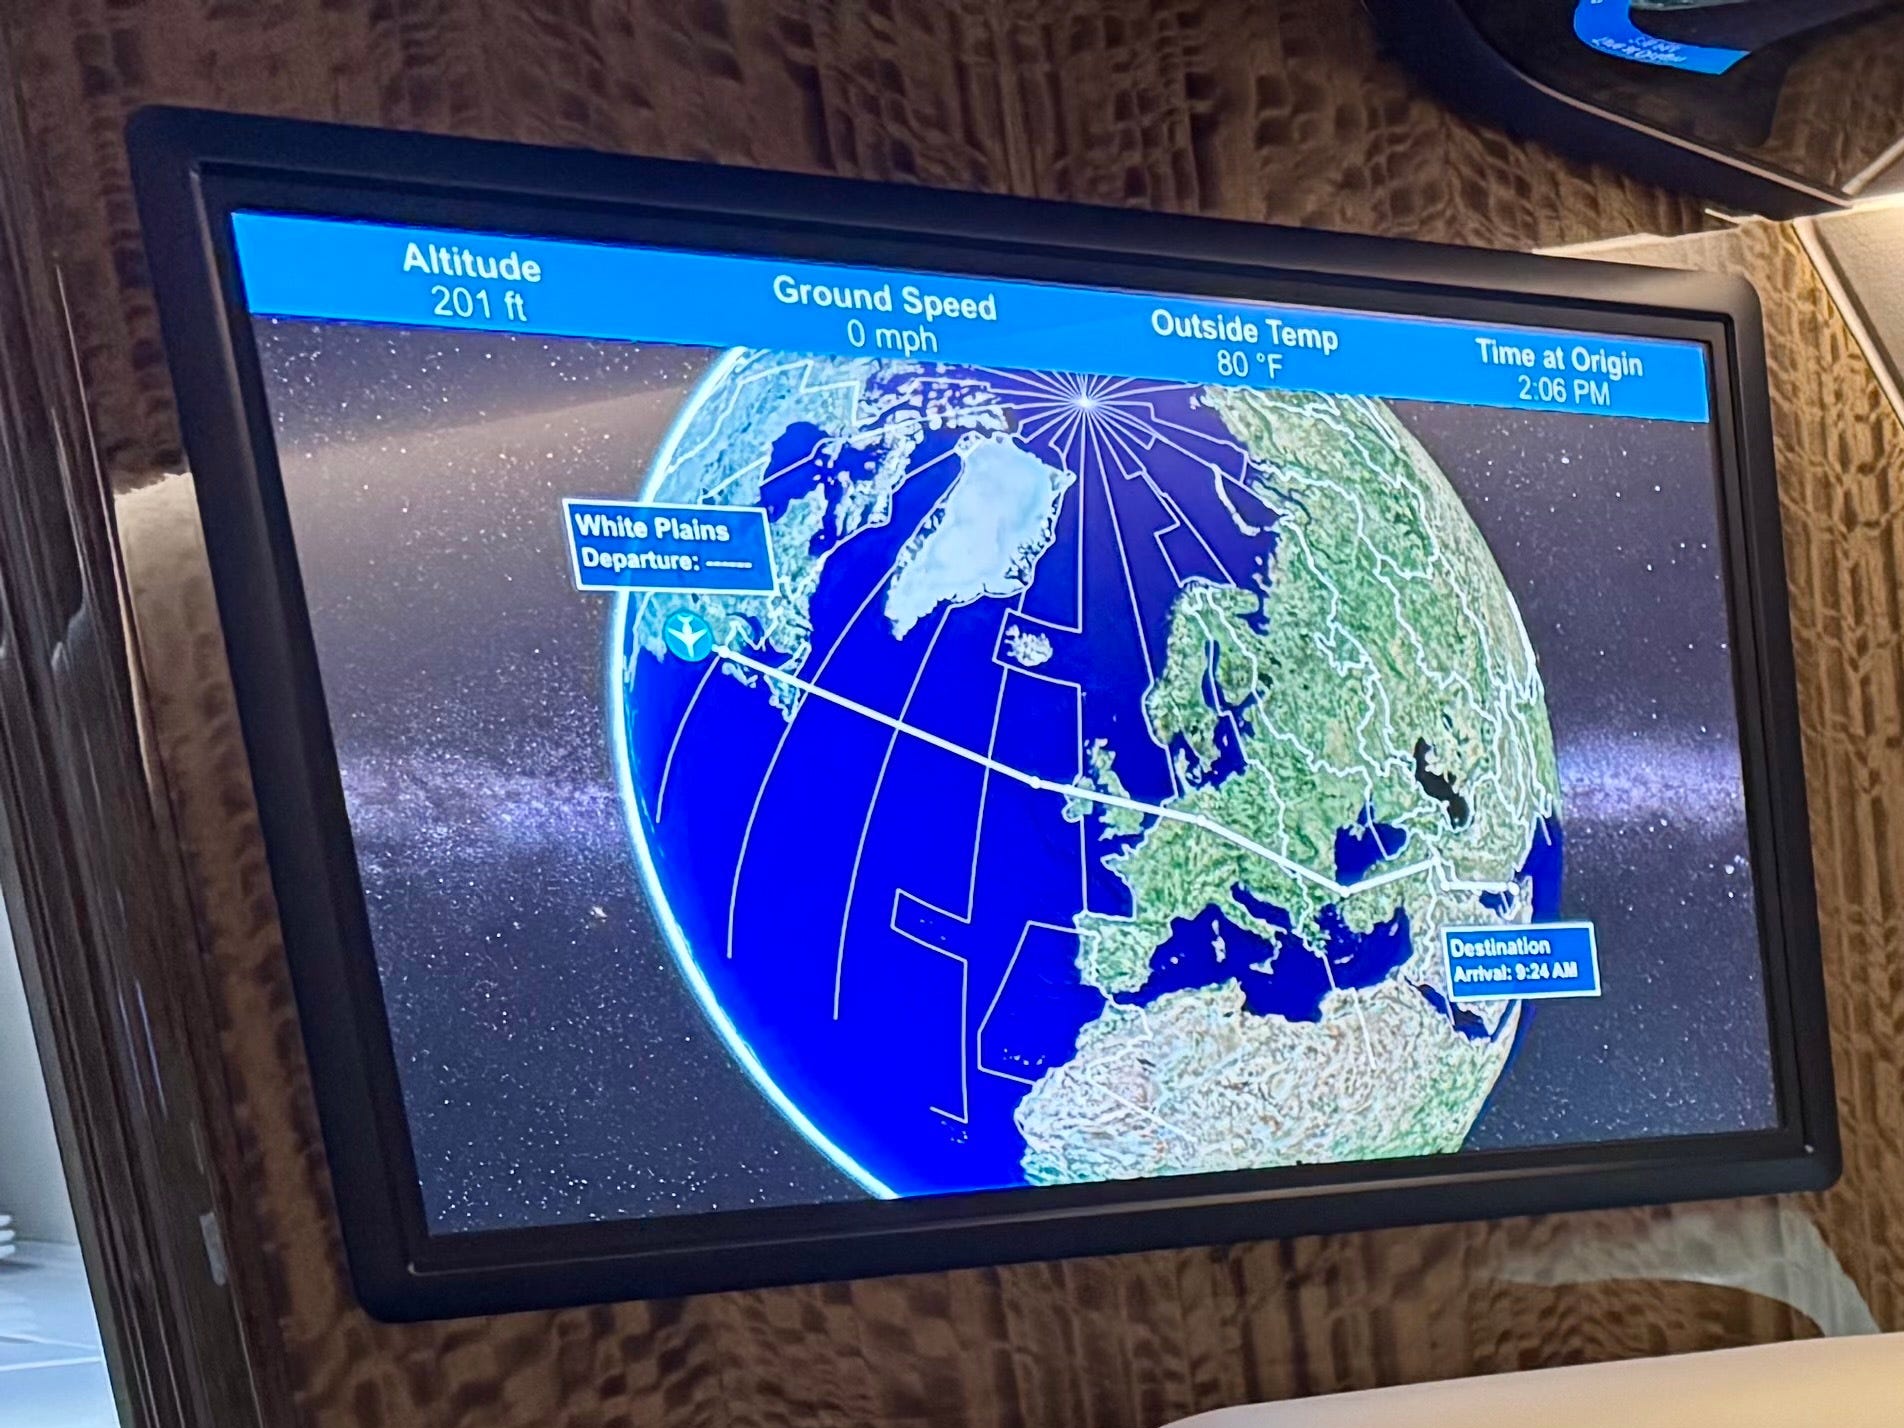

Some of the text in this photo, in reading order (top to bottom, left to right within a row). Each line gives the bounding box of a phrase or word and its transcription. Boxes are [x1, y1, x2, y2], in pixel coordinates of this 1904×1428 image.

[403, 241, 542, 285] Altitude
[431, 284, 528, 323] 201 ft
[773, 274, 997, 326] Ground Speed
[847, 318, 939, 357] 0 mph
[1152, 308, 1339, 353] Outside Temp
[1217, 350, 1284, 380] 80 °F
[1475, 337, 1644, 379] Time at Origin
[1519, 375, 1611, 407] 2:06 PM
[575, 512, 730, 542] White Plains
[581, 547, 700, 573] Departure:
[1450, 936, 1551, 958] Destination
[1454, 961, 1578, 982] Arrival: 9:24 AM
